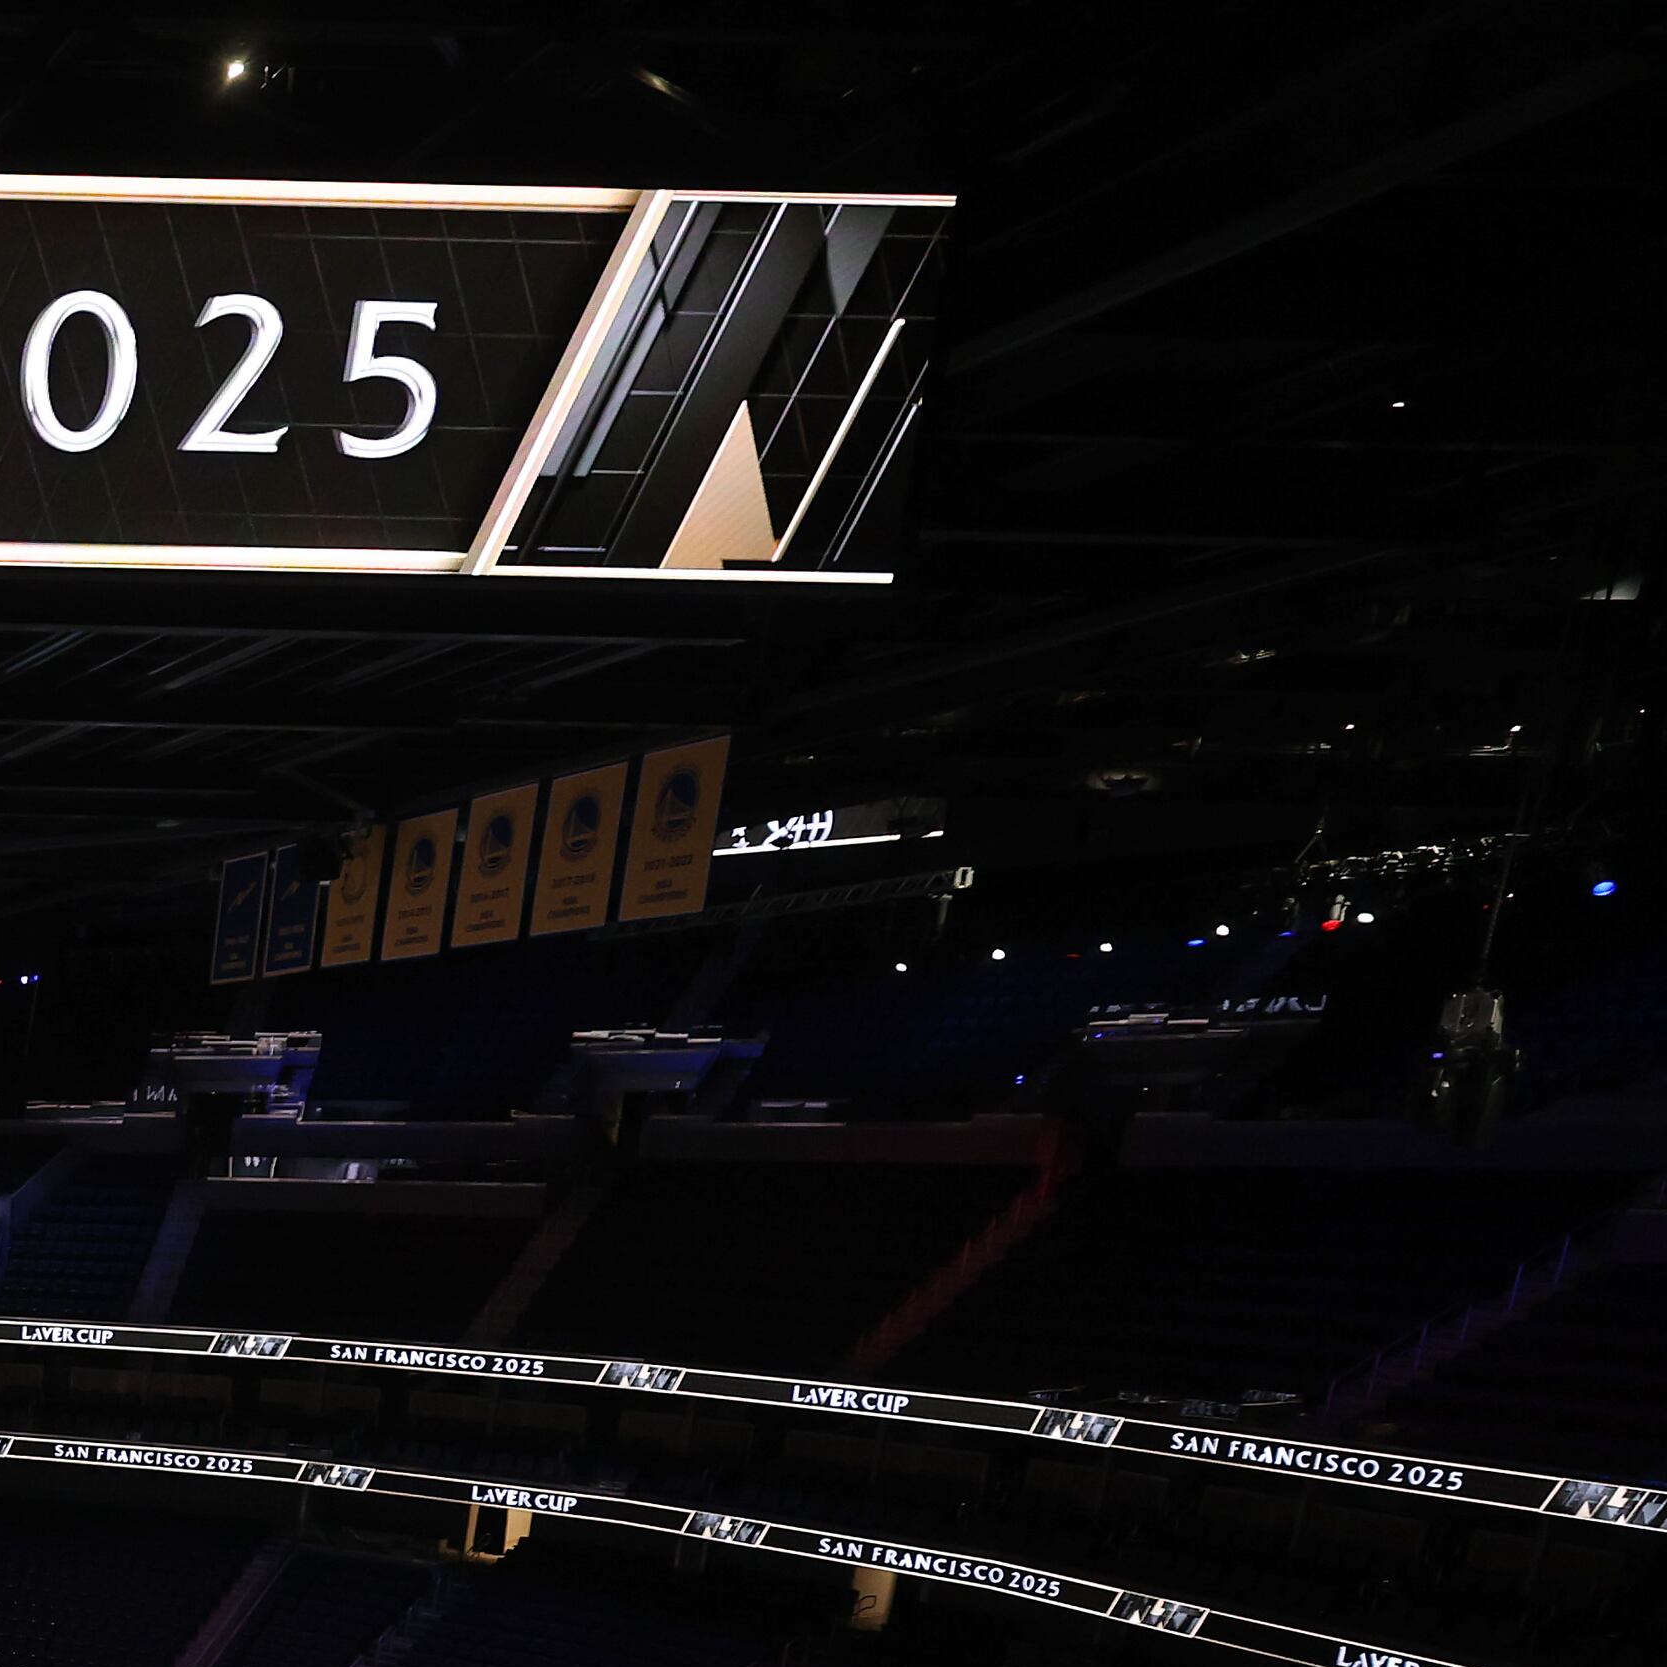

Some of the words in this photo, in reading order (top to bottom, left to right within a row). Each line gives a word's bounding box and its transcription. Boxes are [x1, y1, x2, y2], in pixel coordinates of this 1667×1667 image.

[21, 1326, 75, 1344] LAVER
[76, 1330, 114, 1344] CUP
[330, 1344, 368, 1361] SAN
[374, 1347, 487, 1371] FRANCISCO
[493, 1356, 545, 1376] 2025
[792, 1385, 857, 1408] LAVER
[860, 1391, 909, 1414] CUP
[54, 1444, 89, 1460] SAN
[97, 1448, 201, 1468] FRANCISCO
[206, 1456, 254, 1474] 2025
[1170, 1432, 1220, 1456] SAN
[1227, 1440, 1380, 1479] FRANCISCO
[1387, 1462, 1464, 1491] 2025
[471, 1485, 531, 1508] LAVER
[533, 1493, 578, 1513] CUP
[819, 1538, 864, 1559] SAN
[871, 1545, 1005, 1584] FRANCISCO
[1008, 1571, 1061, 1598] 2025
